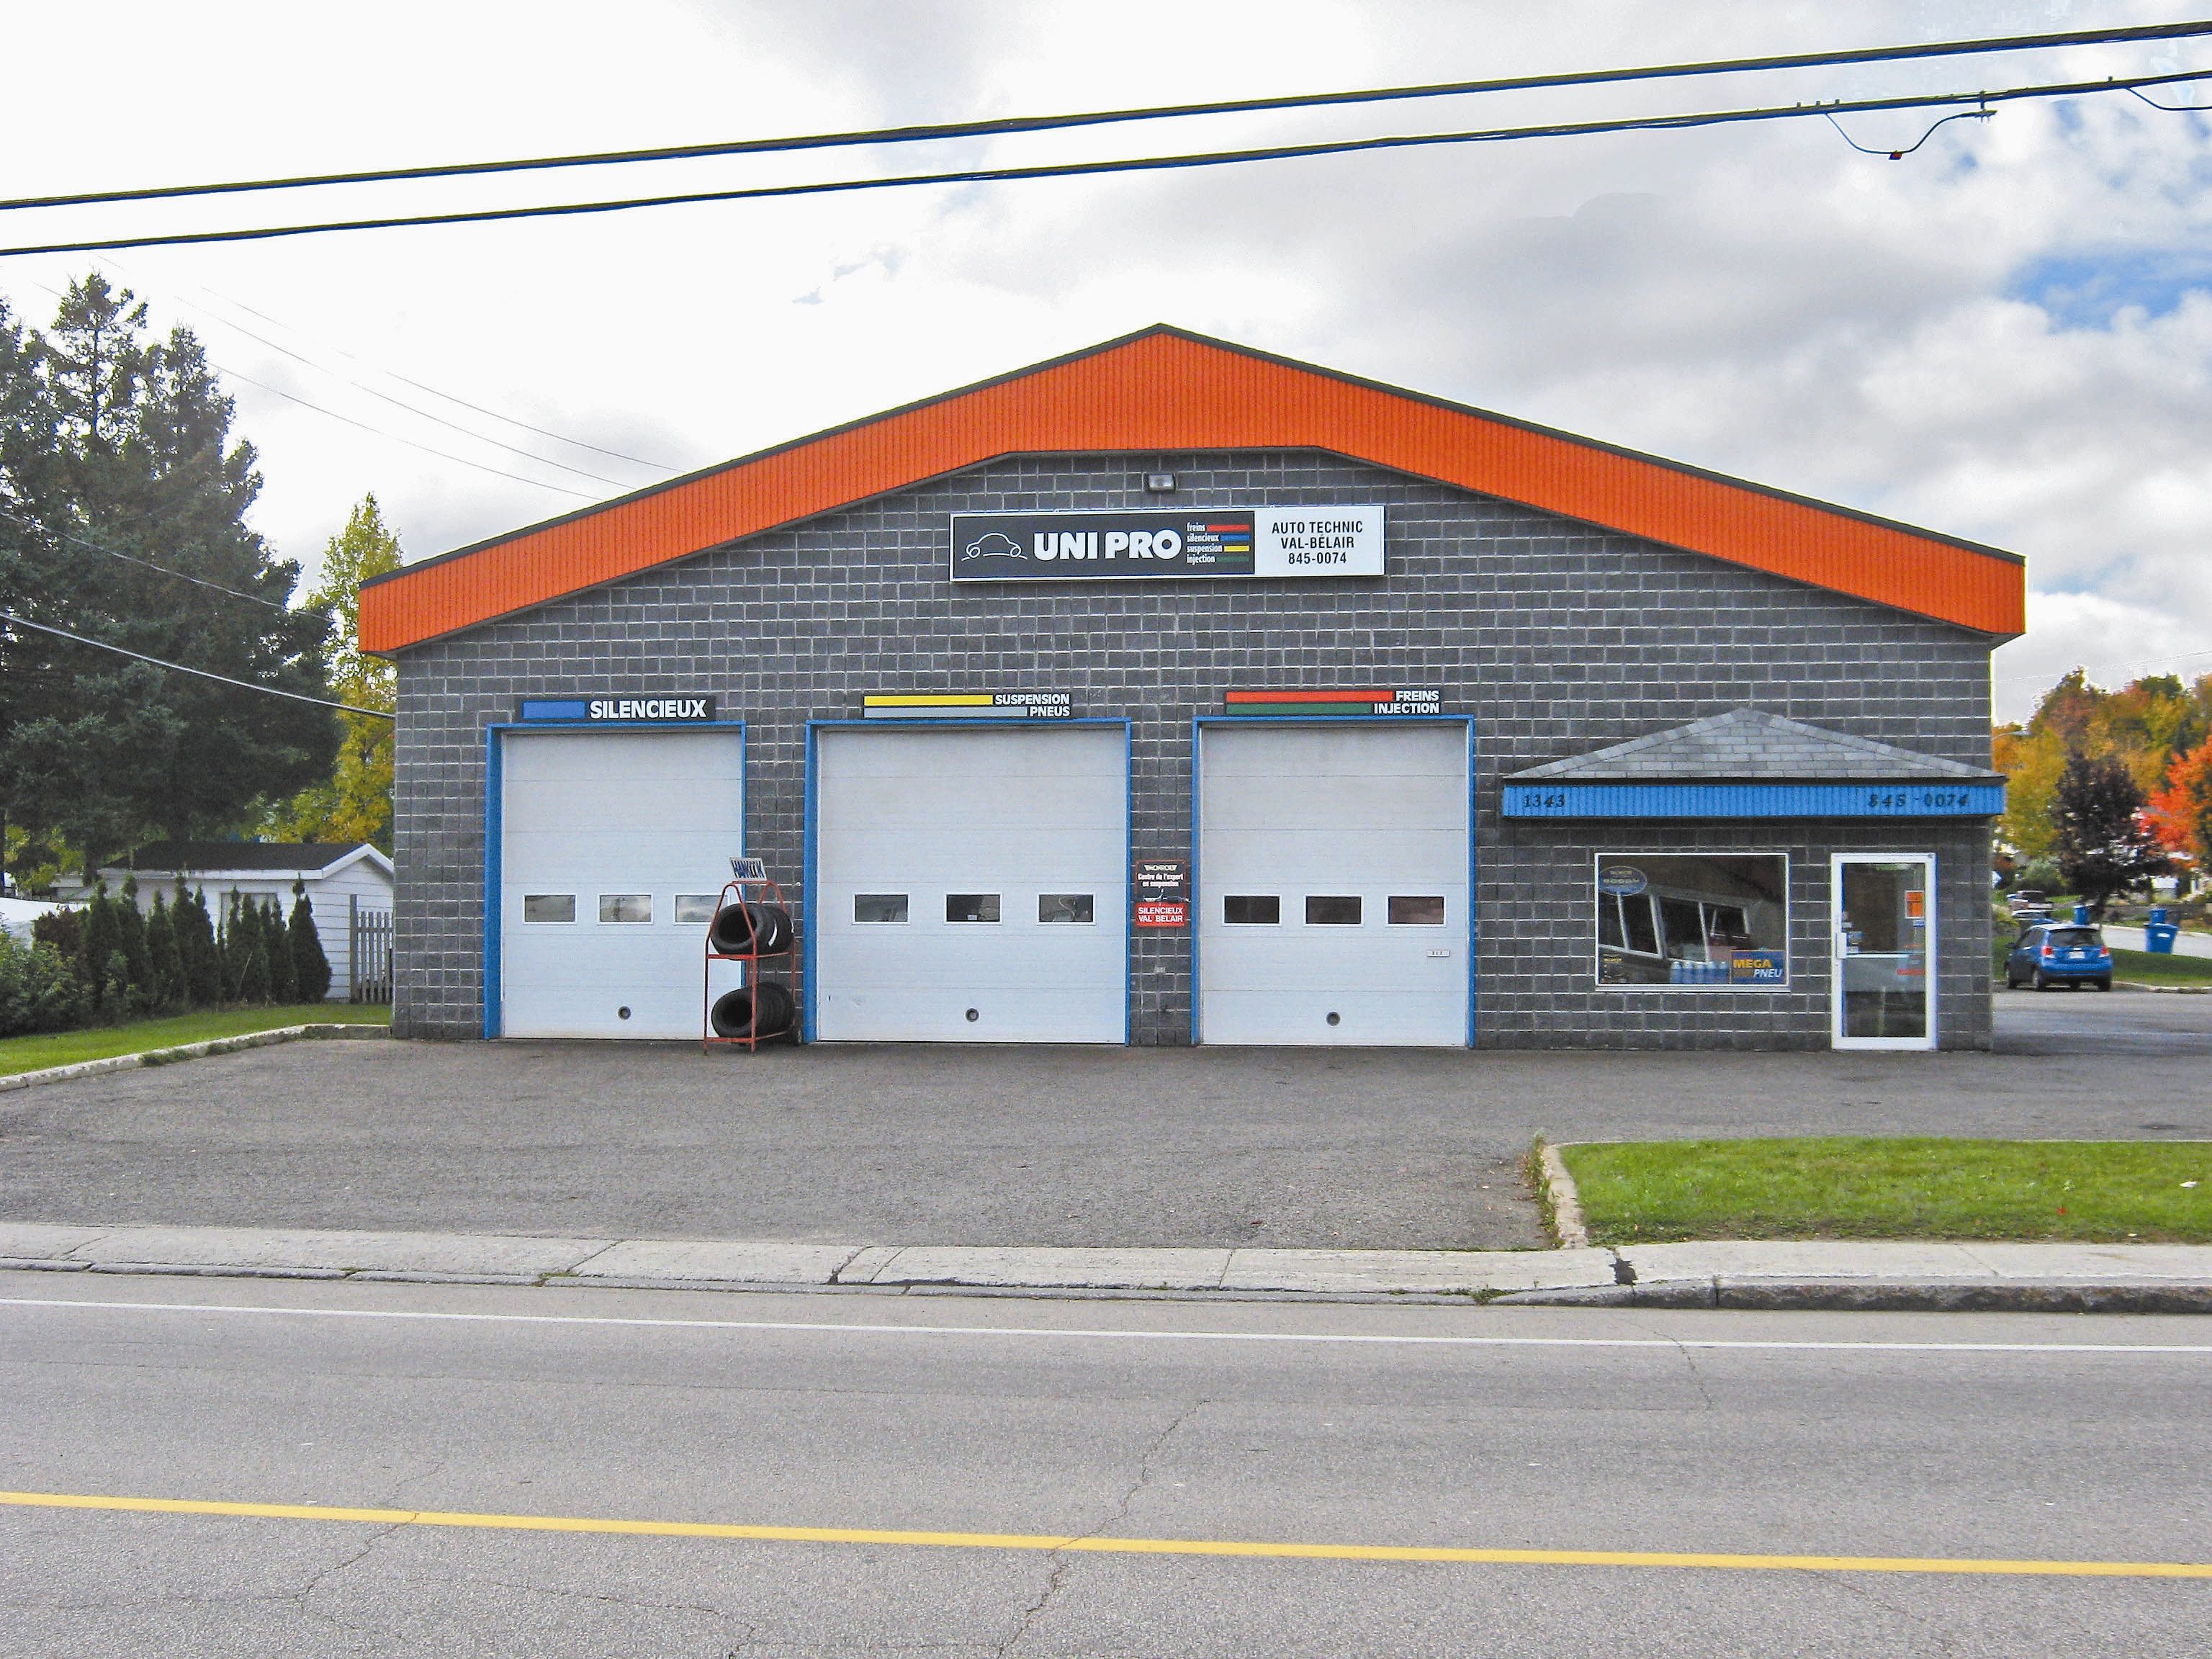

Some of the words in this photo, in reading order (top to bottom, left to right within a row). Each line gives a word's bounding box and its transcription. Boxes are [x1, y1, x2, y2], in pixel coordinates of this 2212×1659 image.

[1187, 522, 1205, 531] freins
[1272, 522, 1305, 533] AUTO
[1309, 521, 1363, 533] TECHNIC
[1187, 533, 1219, 542] silencieux
[1281, 534, 1354, 549] VAL-BÉLAIR
[1034, 531, 1098, 561] UNI
[1105, 529, 1182, 560] PRO
[1187, 544, 1223, 554] suspension
[1187, 554, 1215, 565] injection
[1288, 552, 1346, 564] 845-0074
[995, 693, 1071, 705] SUSPENSION
[1395, 690, 1439, 701] FREINS
[590, 700, 707, 719] SILENCIEUX
[1029, 706, 1071, 717] PNEUS
[1374, 702, 1439, 714] INJECTION
[1524, 794, 1565, 807] 1343
[1733, 959, 1772, 968] MEGA
[1753, 968, 1783, 978] PNEU
